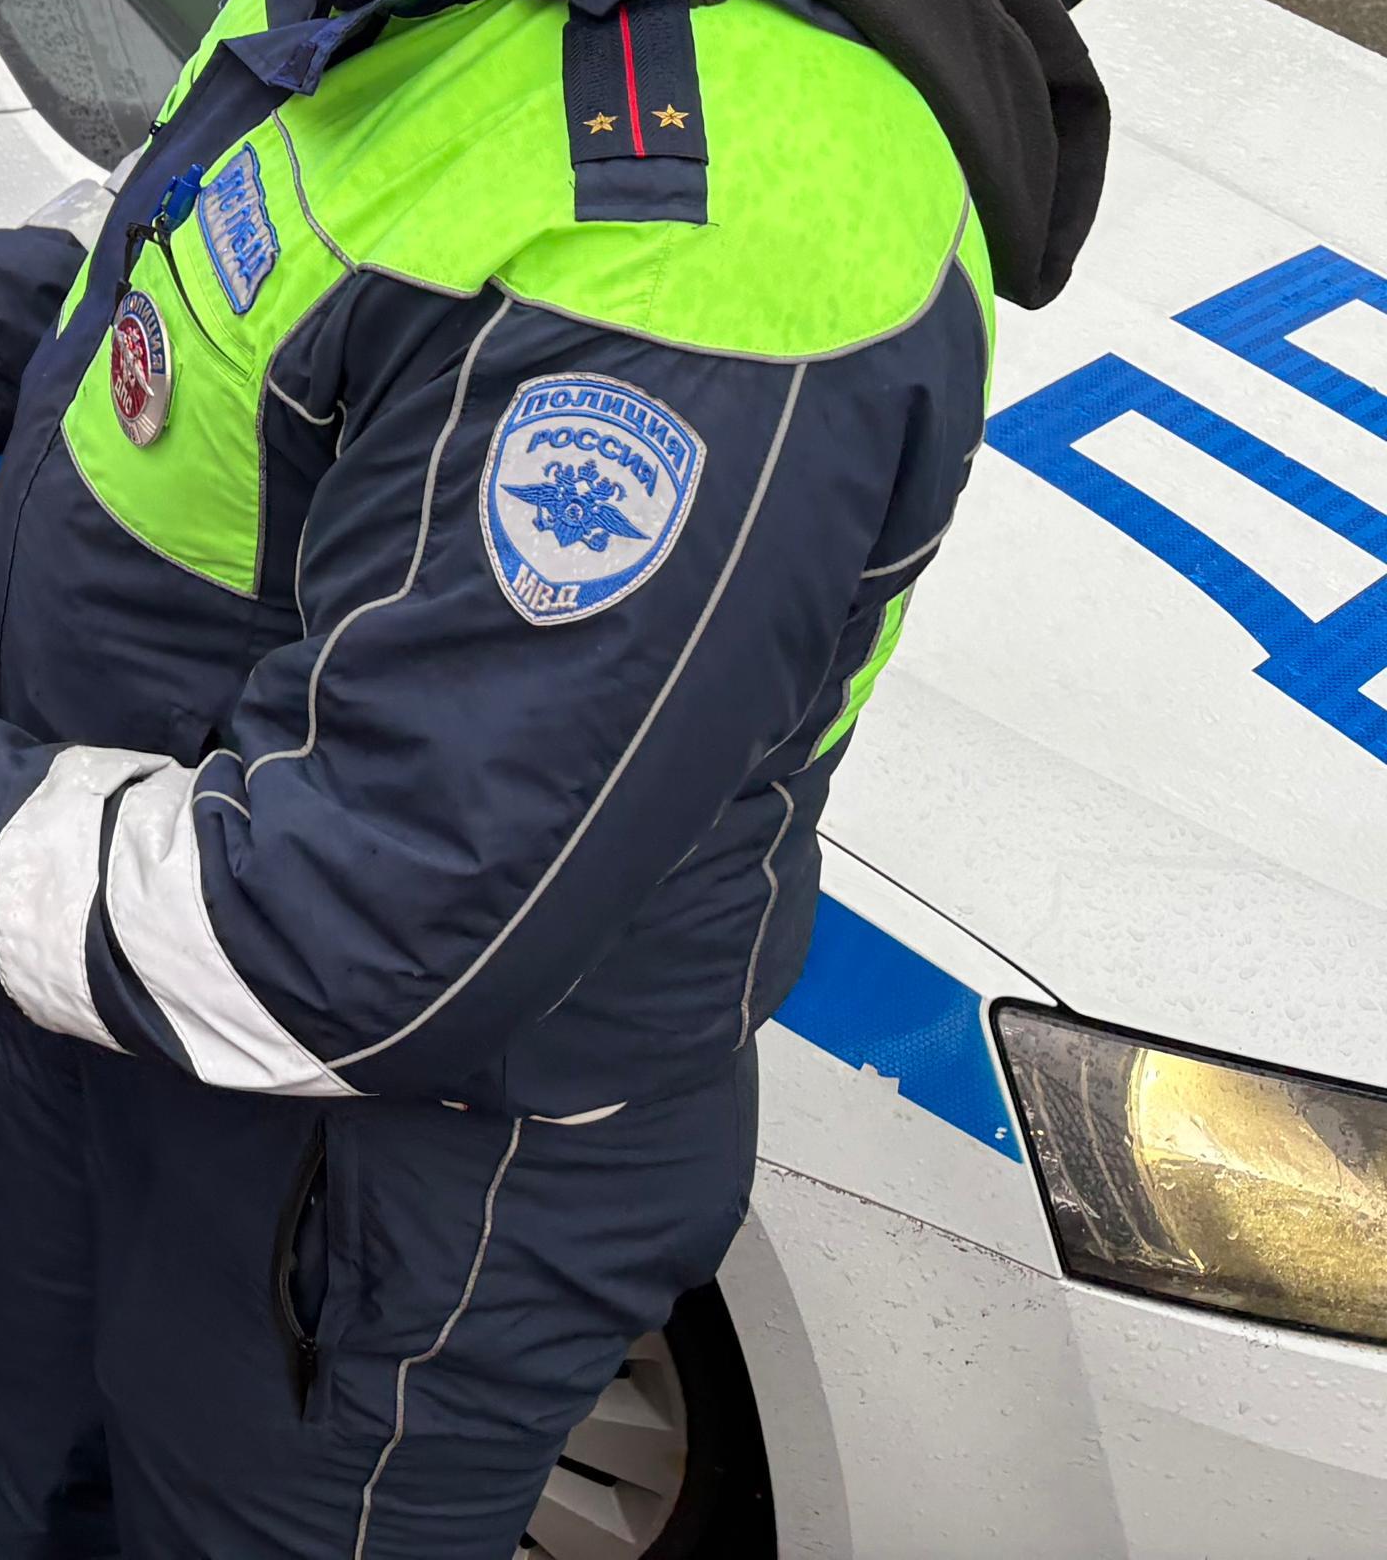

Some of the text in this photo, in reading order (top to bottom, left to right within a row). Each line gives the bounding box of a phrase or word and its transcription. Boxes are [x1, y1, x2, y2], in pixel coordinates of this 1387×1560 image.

[520, 388, 688, 471] ПОЛИЦИЯ
[526, 425, 660, 498] РОССИЯ
[511, 562, 582, 612] МВД
